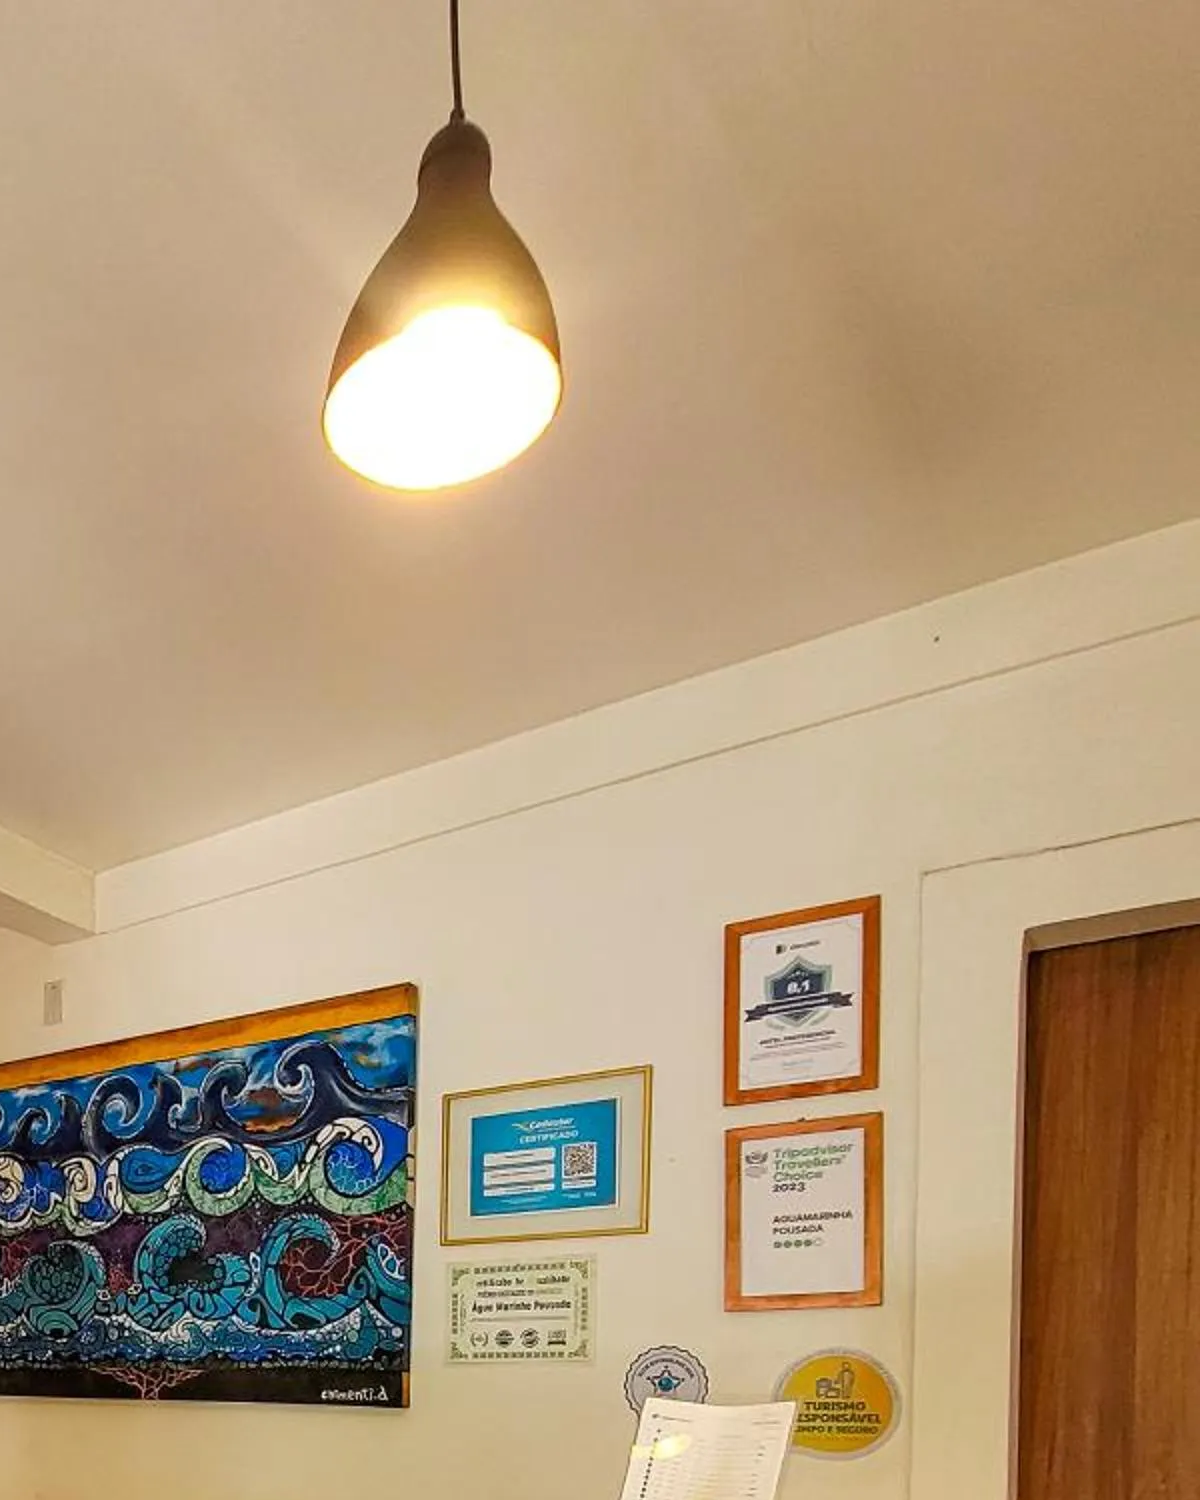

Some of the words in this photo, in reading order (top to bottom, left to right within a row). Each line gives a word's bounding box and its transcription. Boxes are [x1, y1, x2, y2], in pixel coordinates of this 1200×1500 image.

[774, 1144, 854, 1158] Tripadvisor
[773, 1170, 823, 1182] Choice
[772, 1181, 806, 1193] 2023
[773, 1225, 823, 1235] POUSADA
[803, 1401, 867, 1411] TURISMO
[797, 1412, 881, 1424] ESPONSÁVEL
